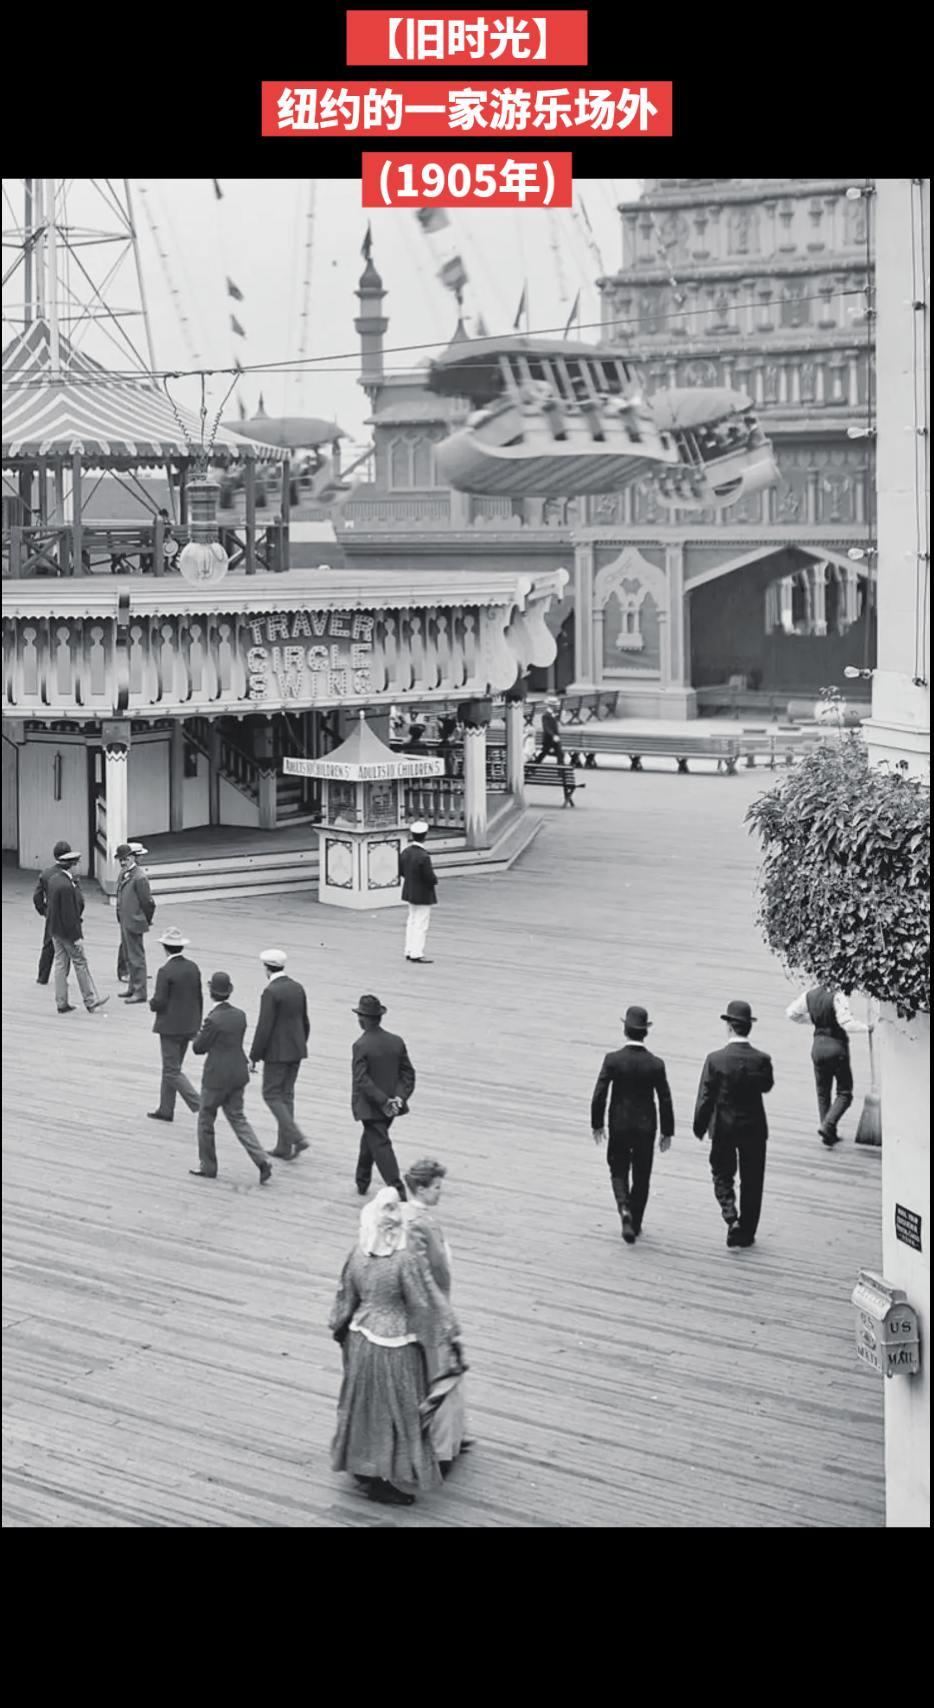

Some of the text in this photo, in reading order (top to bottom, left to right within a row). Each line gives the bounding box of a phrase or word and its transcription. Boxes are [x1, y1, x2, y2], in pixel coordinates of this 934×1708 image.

[249, 612, 374, 644] TRAVER
[247, 644, 372, 673] CIRCLE
[249, 670, 372, 698] SWING
[358, 764, 386, 779] ADULTS
[397, 761, 434, 776] CHILDREN
[890, 1321, 912, 1333] US
[888, 1350, 917, 1365] MAIL
